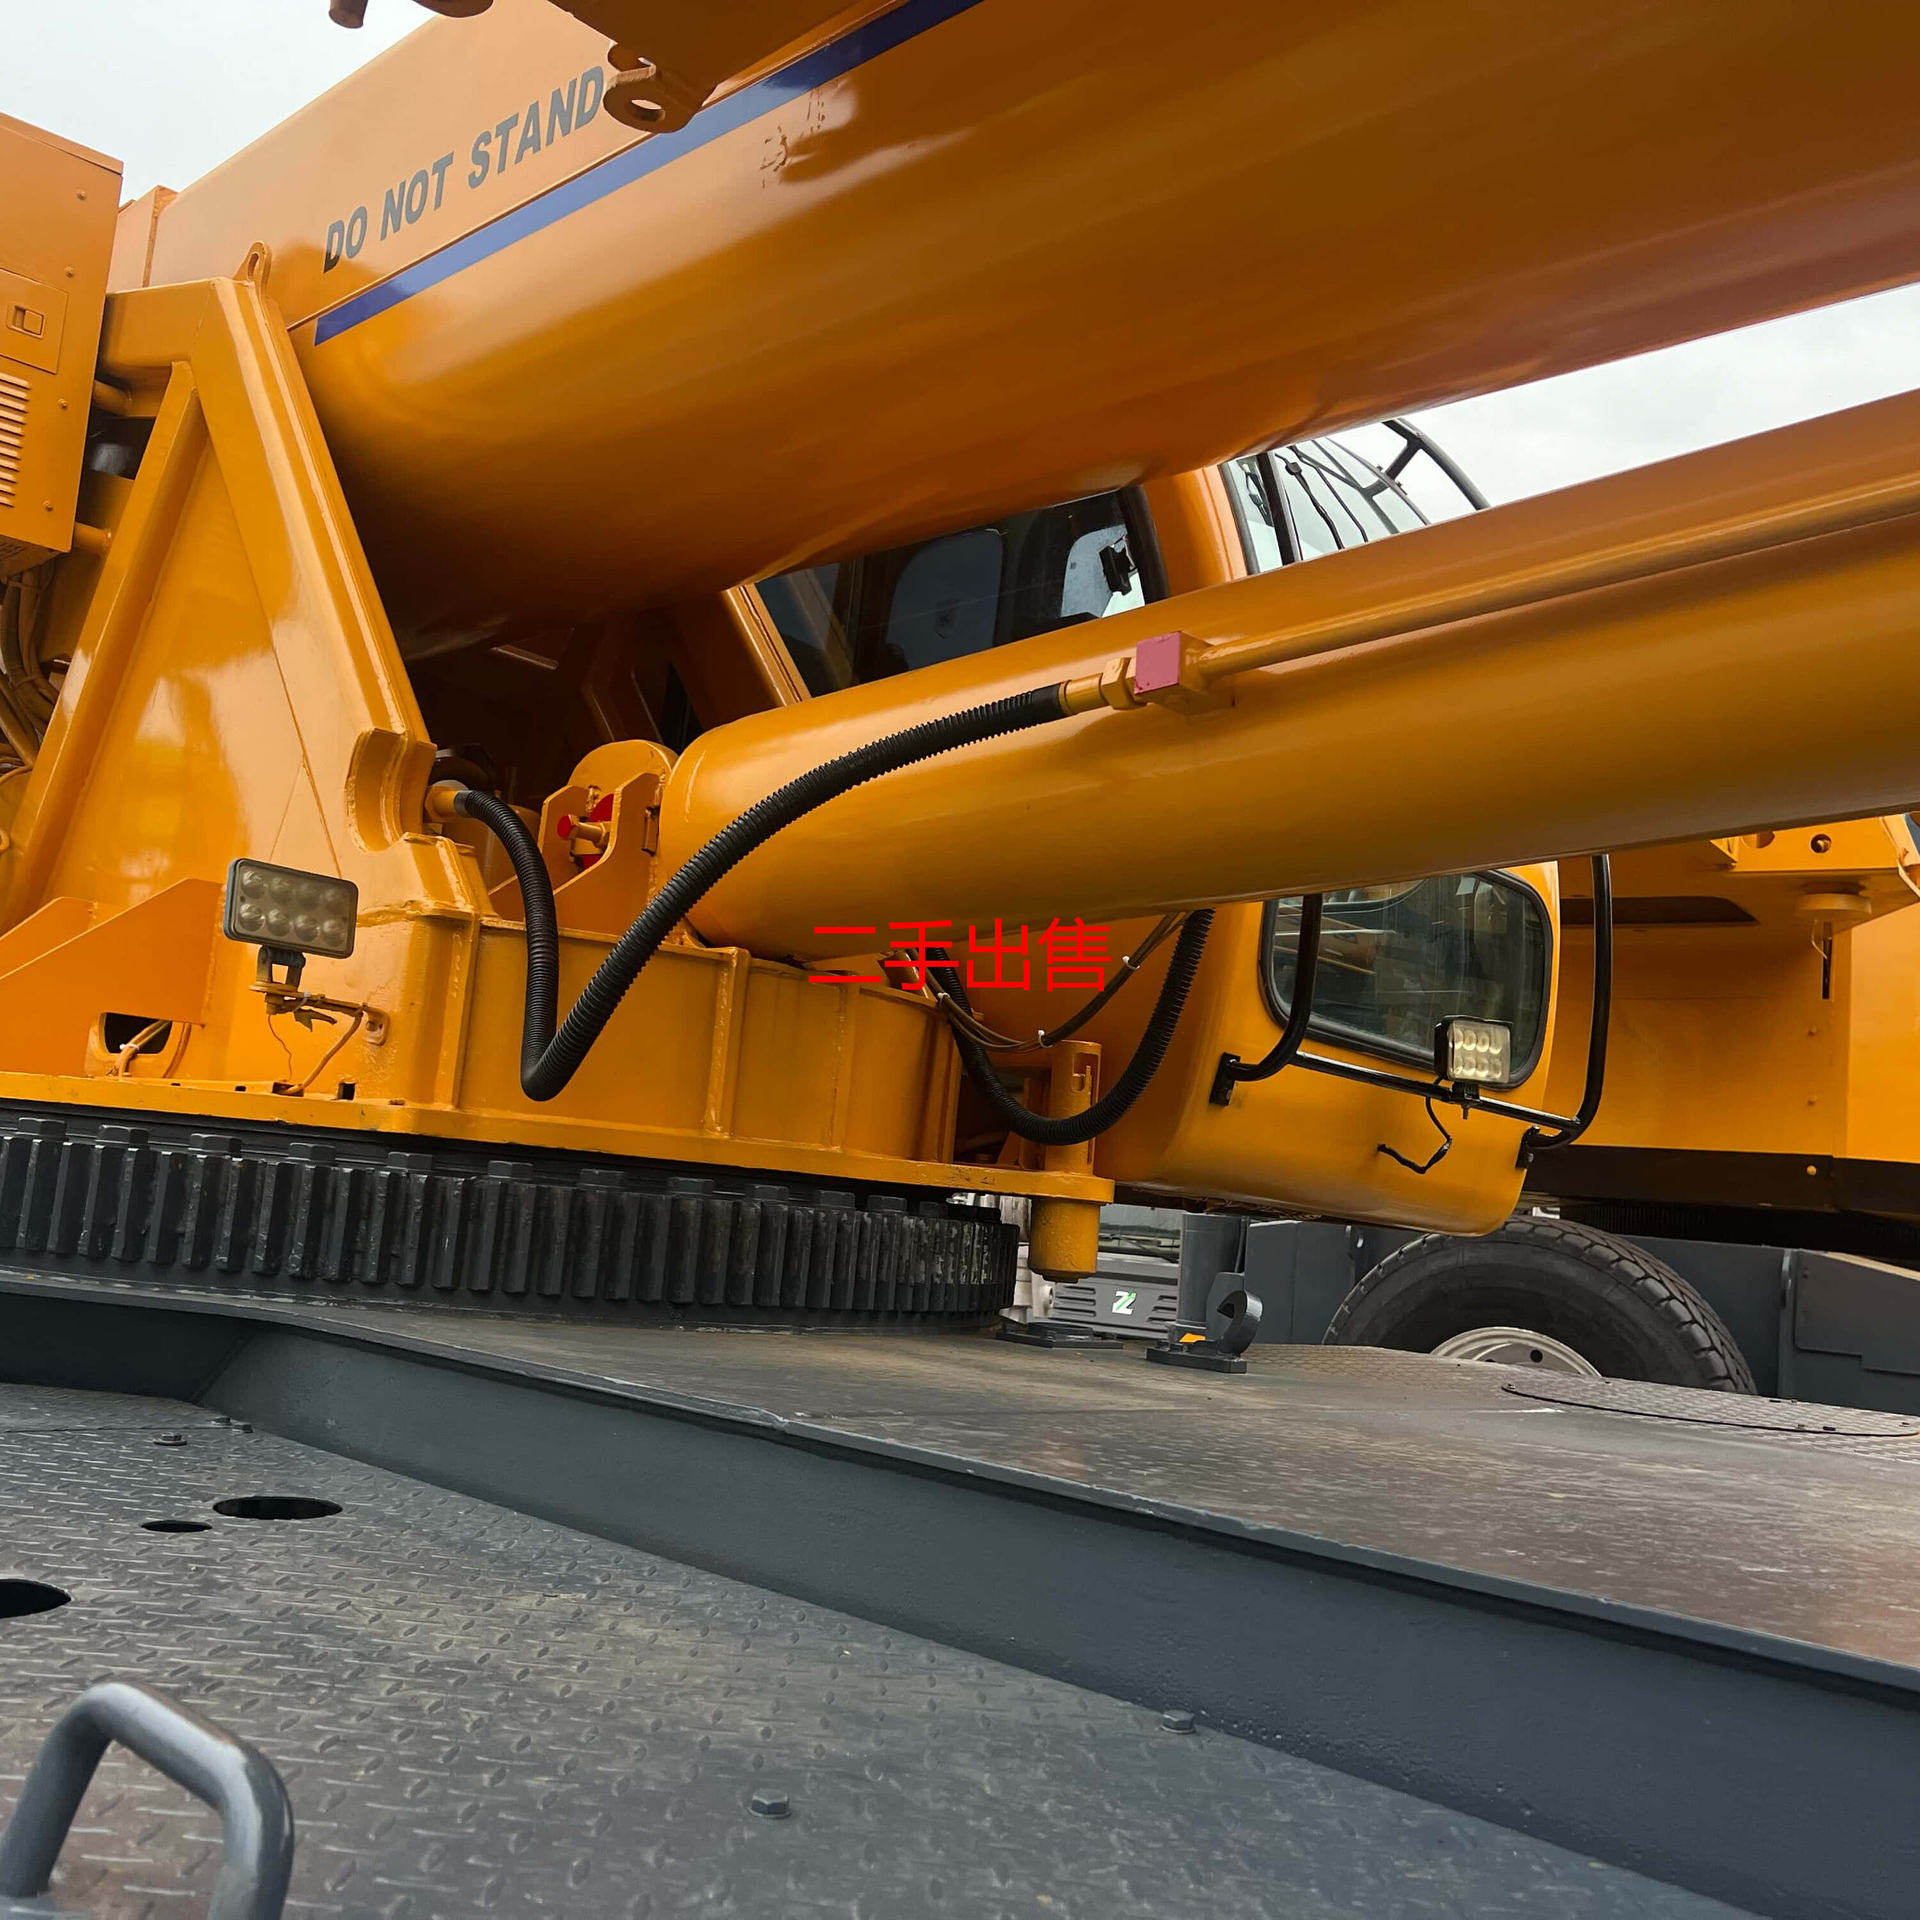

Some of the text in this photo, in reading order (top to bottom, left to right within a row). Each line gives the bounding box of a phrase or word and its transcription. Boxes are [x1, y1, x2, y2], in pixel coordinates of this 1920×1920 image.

[323, 65, 604, 273] DO NOT STAND
